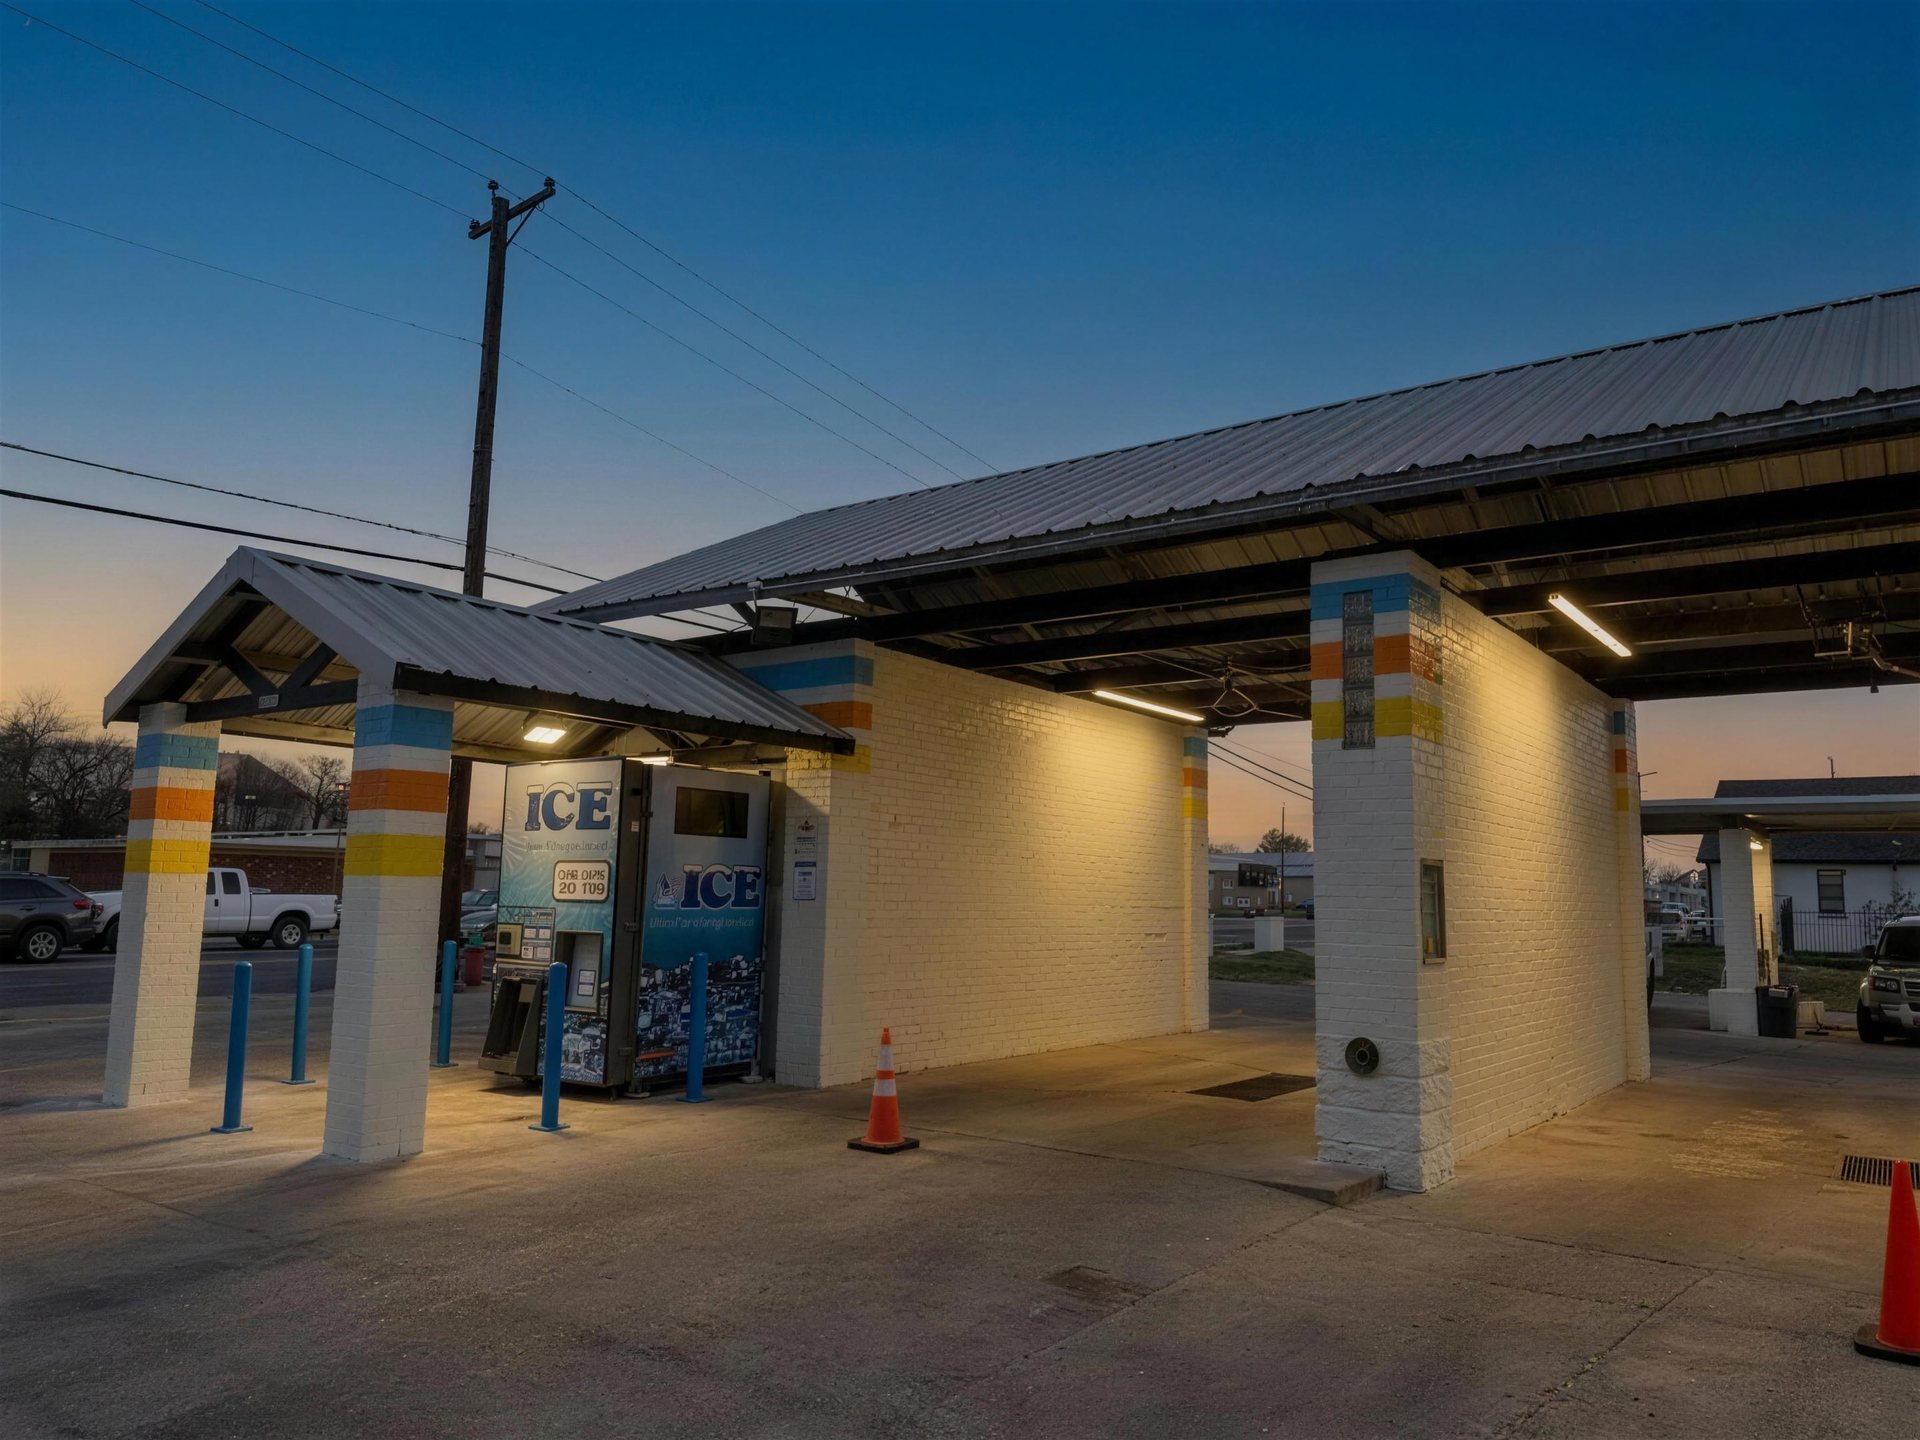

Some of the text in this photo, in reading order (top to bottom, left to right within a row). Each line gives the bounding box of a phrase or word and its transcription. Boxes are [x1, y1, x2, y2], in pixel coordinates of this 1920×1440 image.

[525, 781, 613, 831] ICE
[558, 881, 577, 895] 20
[680, 864, 761, 910] ICE
